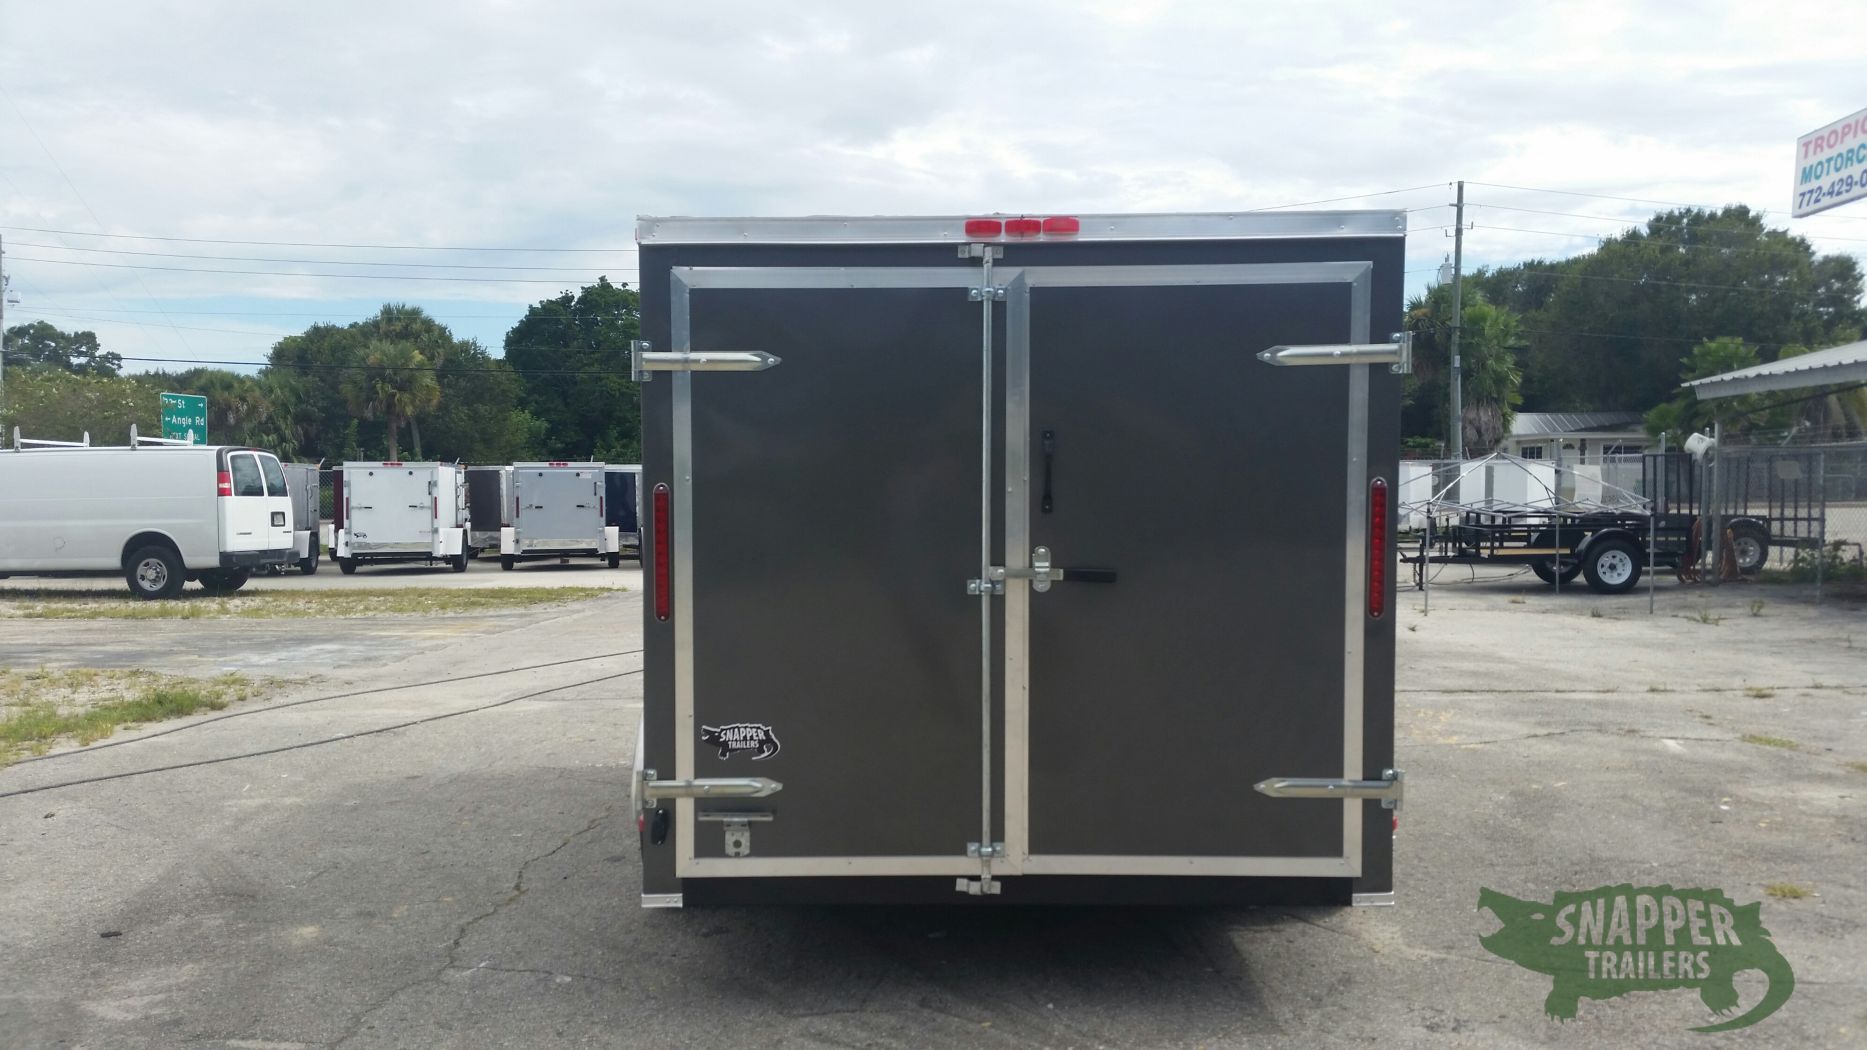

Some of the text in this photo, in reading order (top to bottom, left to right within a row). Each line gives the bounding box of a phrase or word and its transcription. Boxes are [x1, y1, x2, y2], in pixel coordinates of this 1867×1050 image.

[177, 399, 185, 409] St
[171, 415, 205, 428] Angle Rd
[720, 727, 766, 742] SNAPPER
[727, 740, 759, 749] TRAILERS
